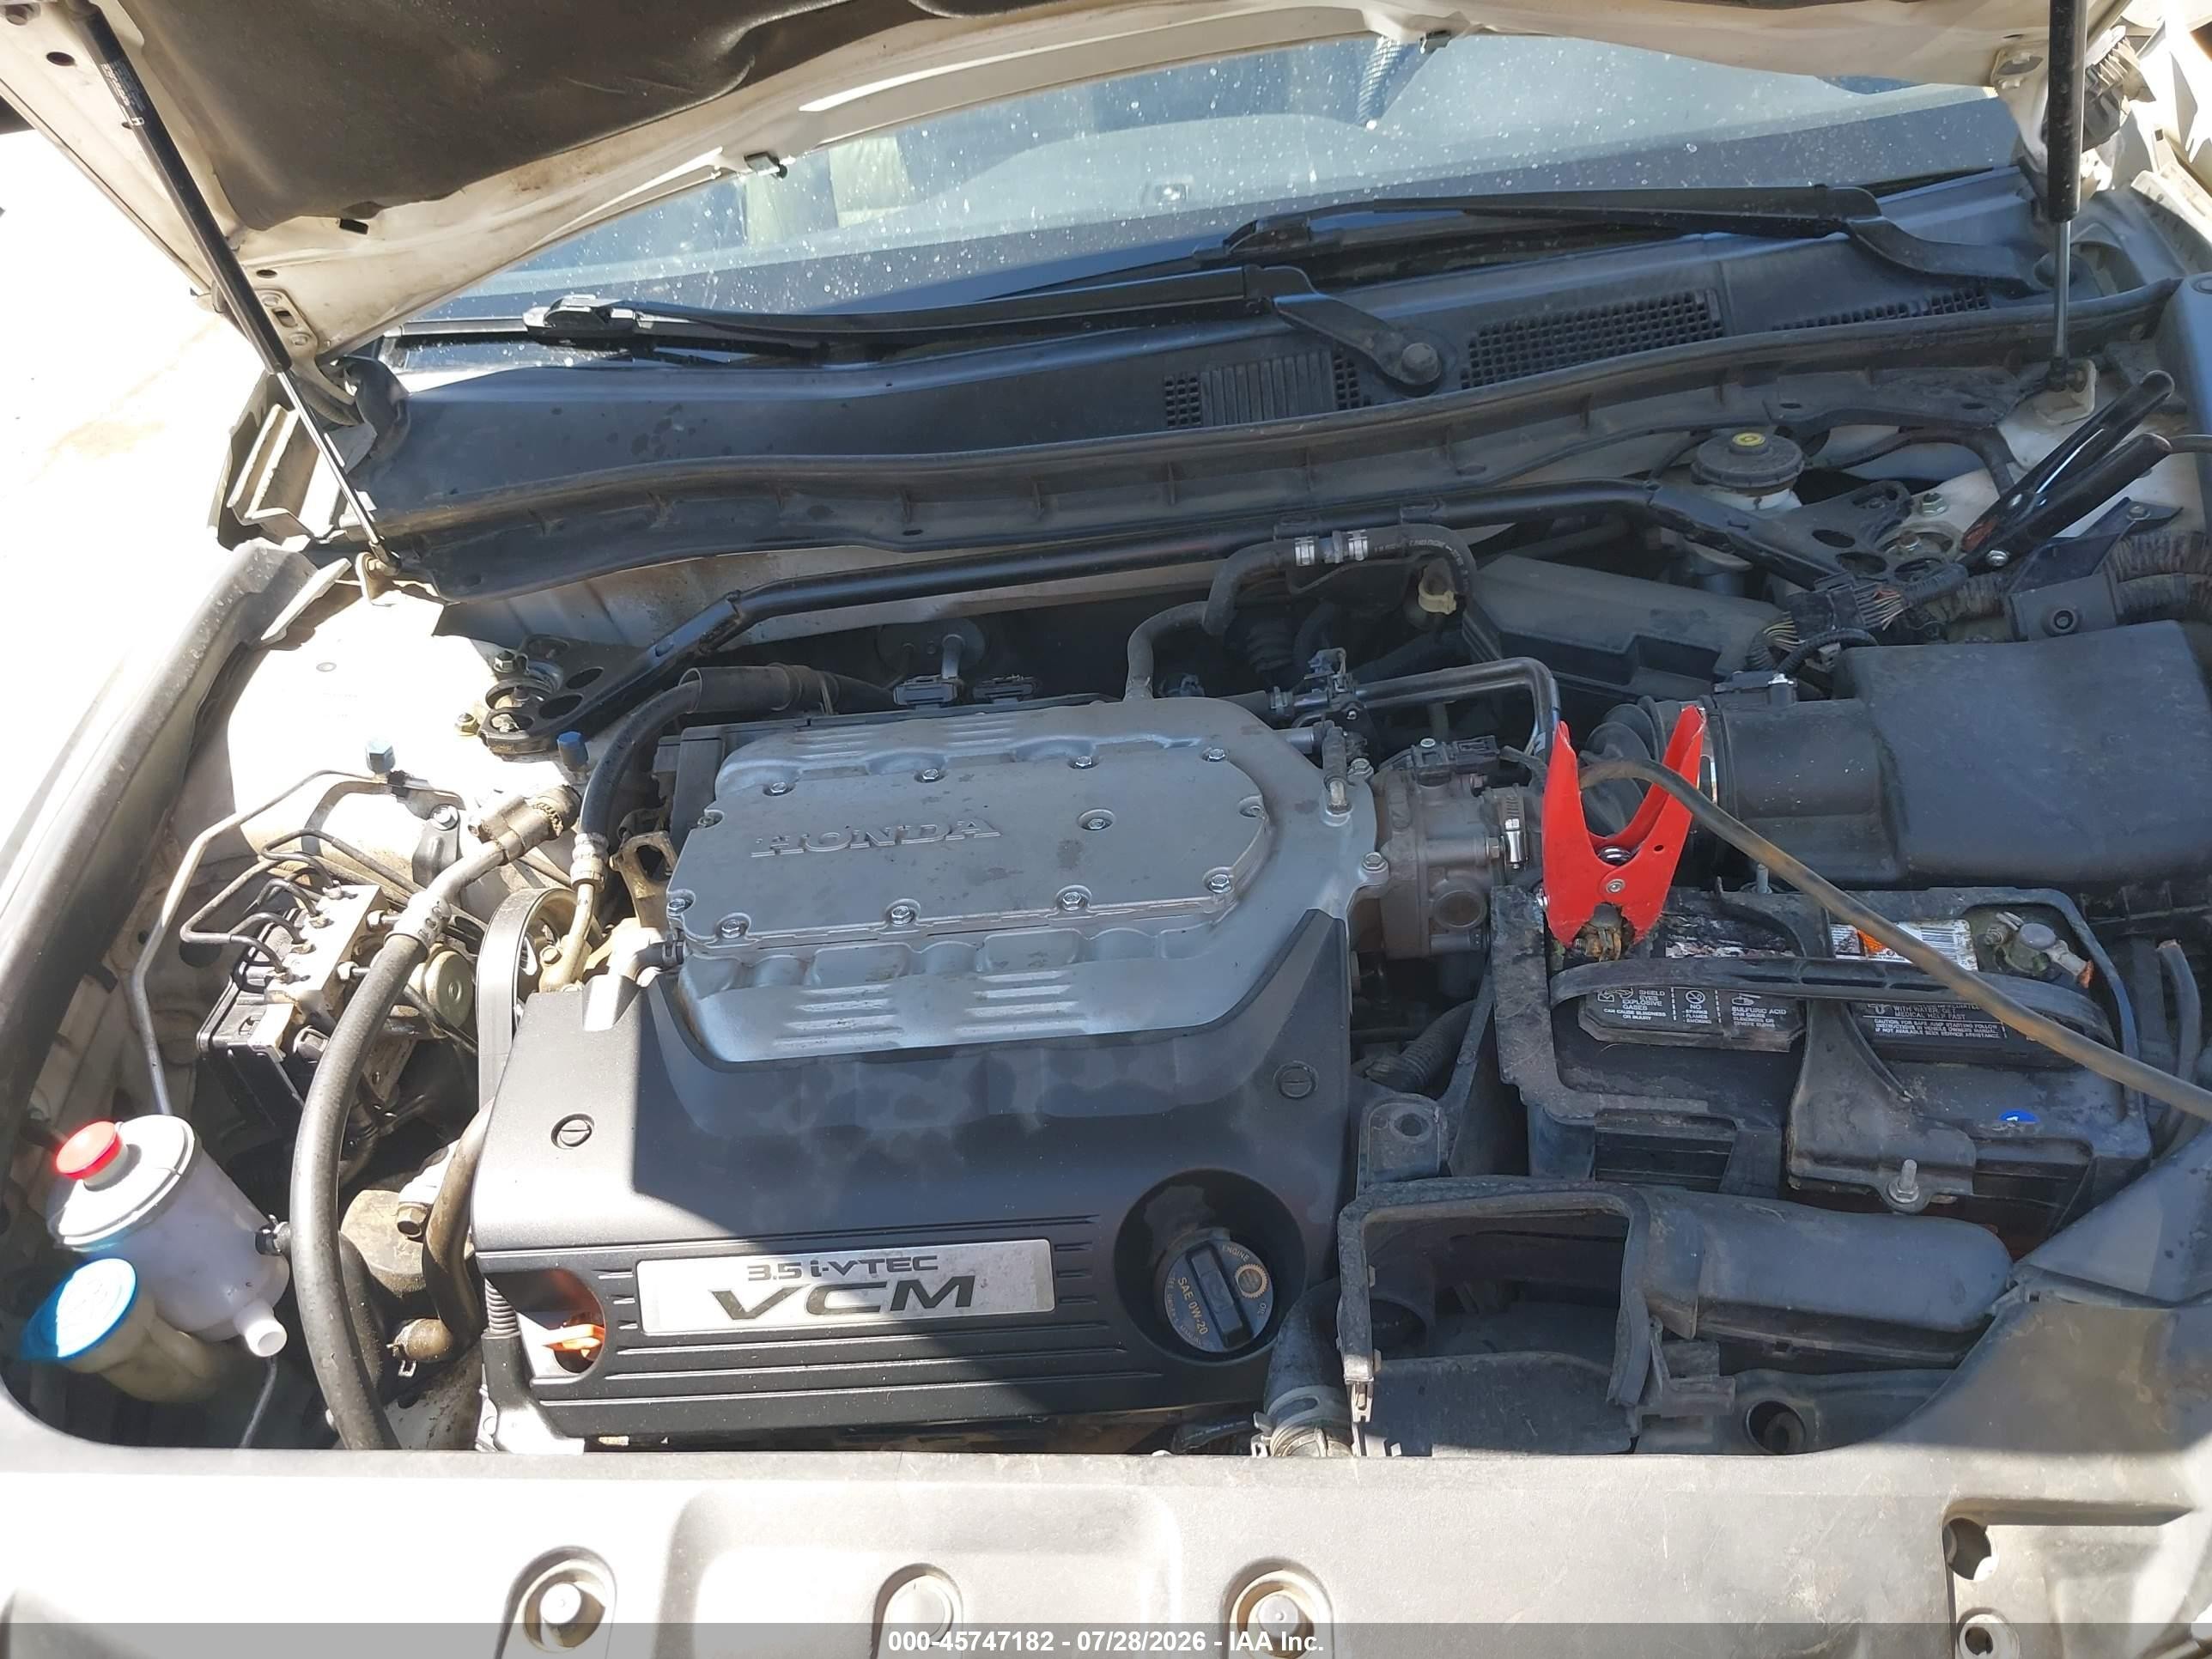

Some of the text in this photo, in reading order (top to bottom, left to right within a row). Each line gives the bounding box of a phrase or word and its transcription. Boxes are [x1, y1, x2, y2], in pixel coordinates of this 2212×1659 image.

[750, 819, 1002, 858] HONDA
[747, 1255, 938, 1281] 3.5 i-VTEC
[1222, 1244, 1250, 1262] ENGINE
[711, 1275, 975, 1320] VCM
[1177, 1277, 1209, 1334] SAE 0W-20
[1256, 1302, 1267, 1316] OIL
